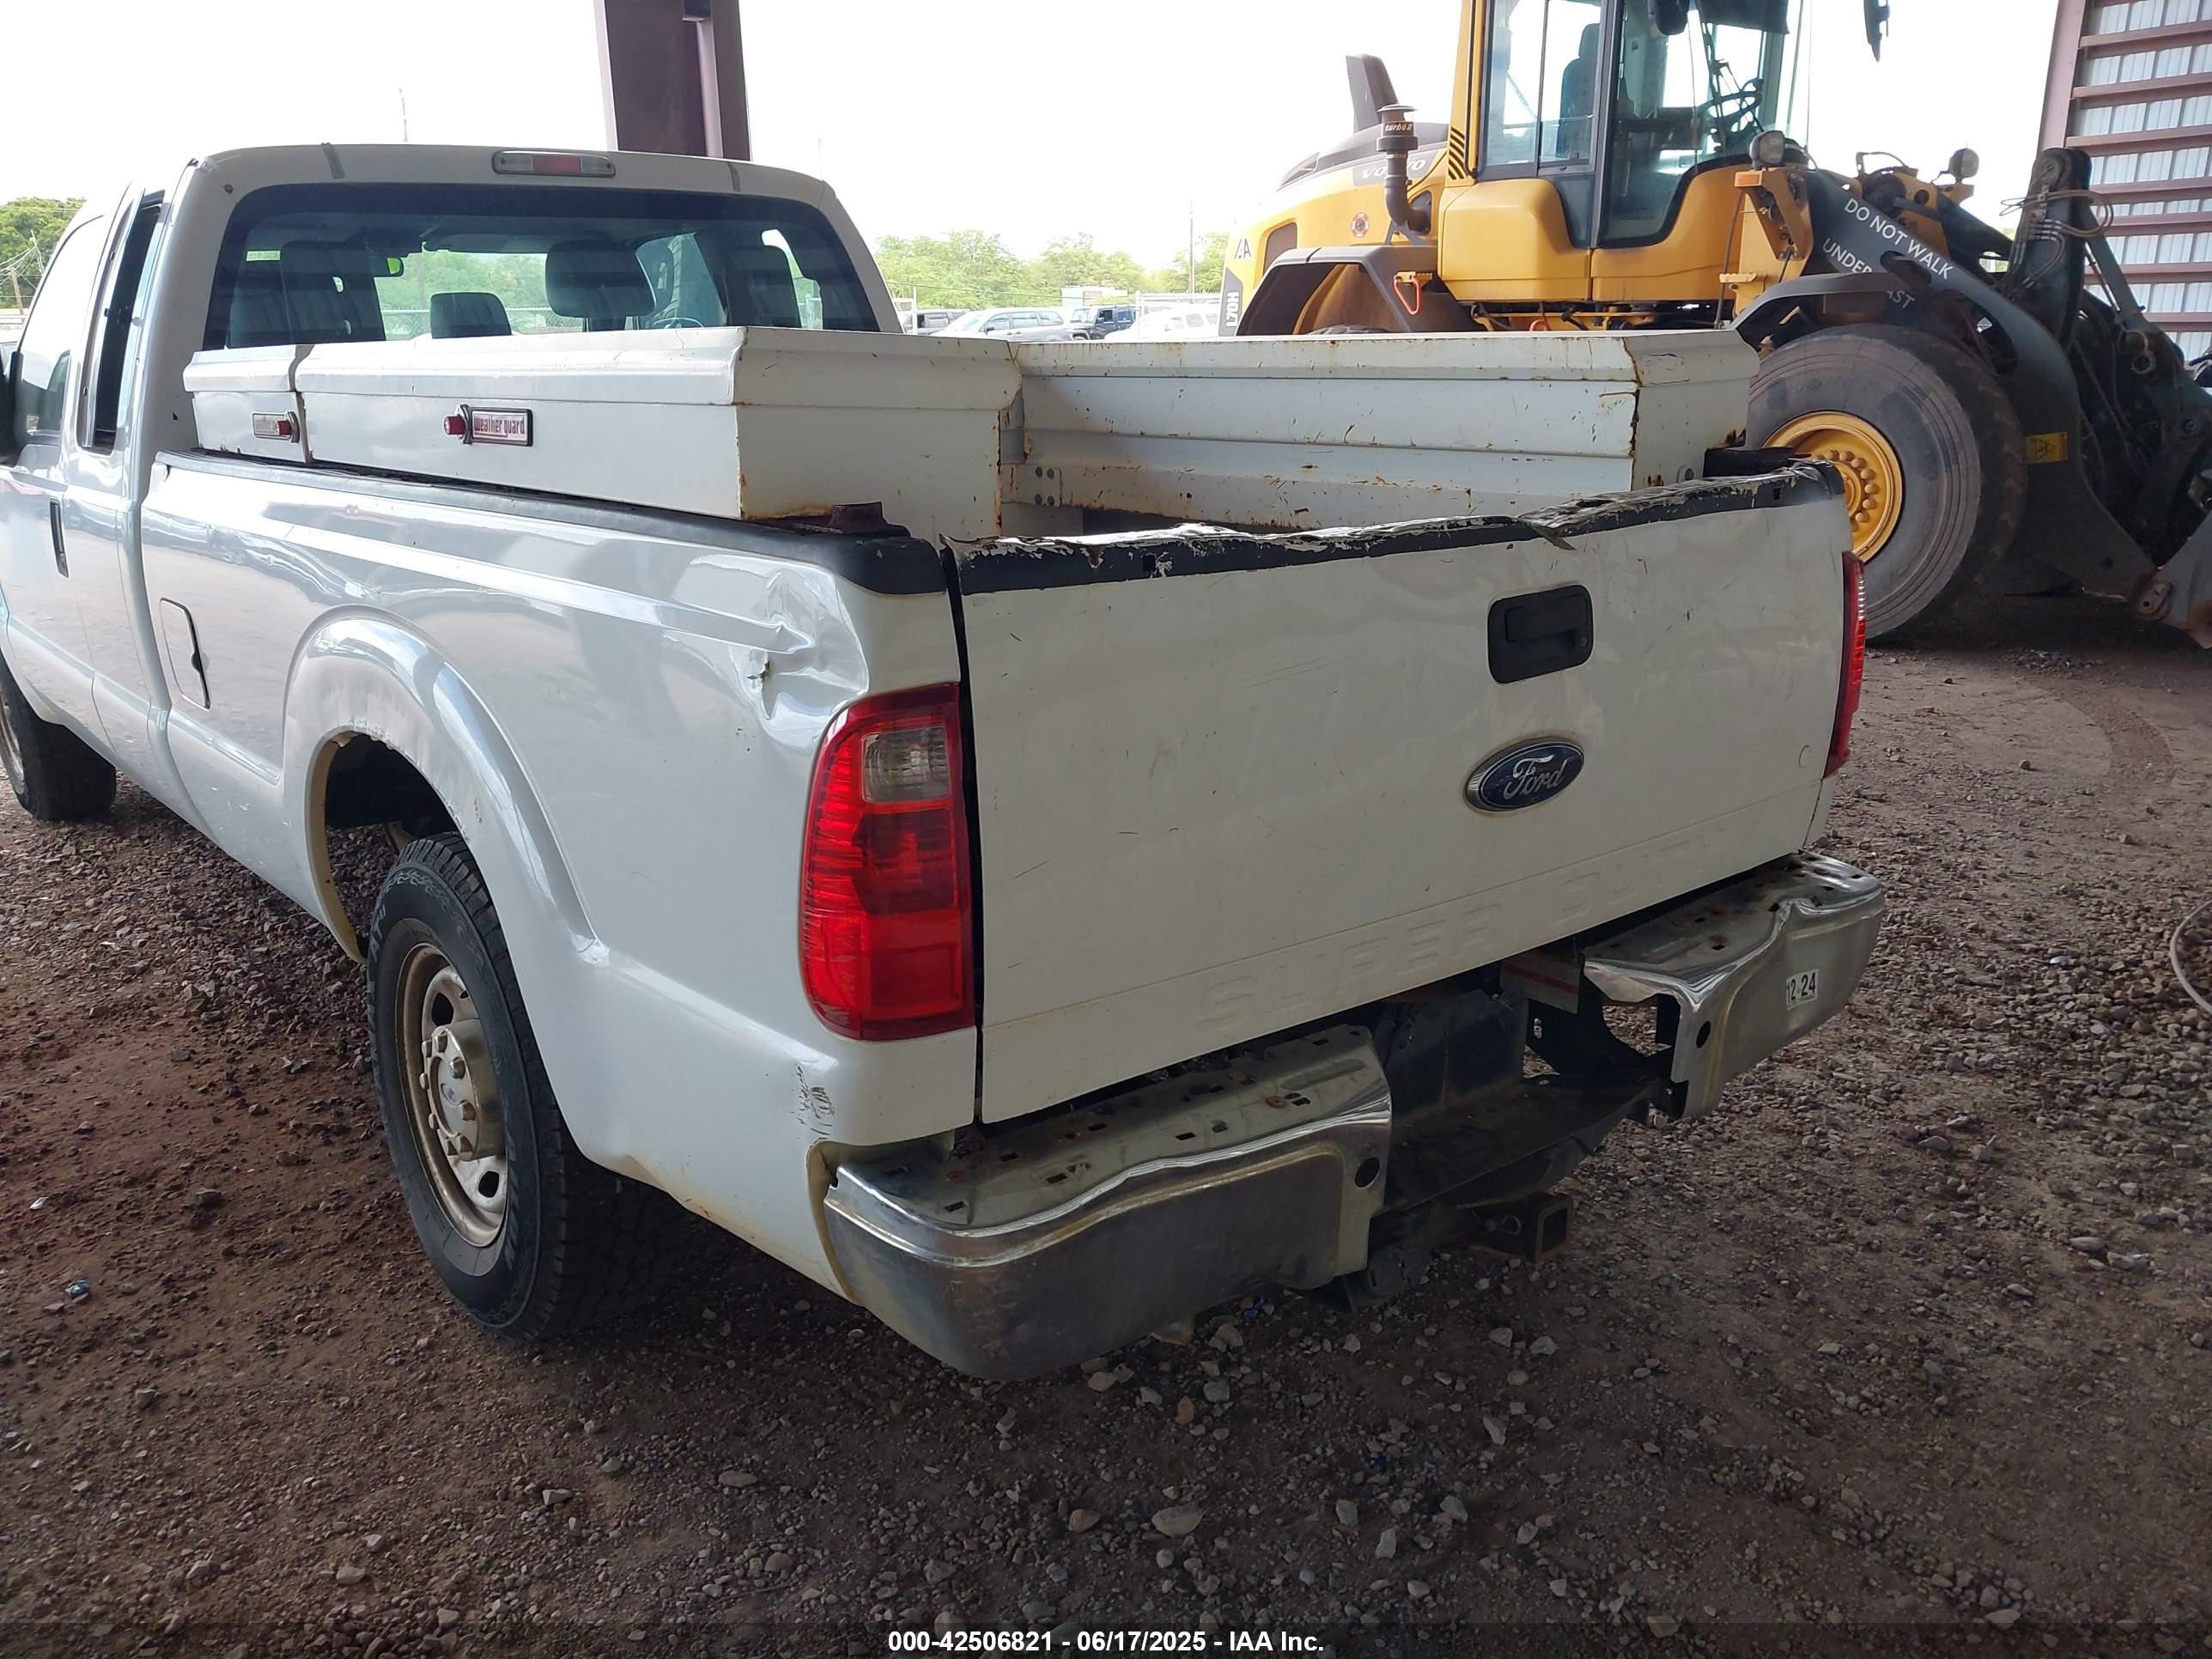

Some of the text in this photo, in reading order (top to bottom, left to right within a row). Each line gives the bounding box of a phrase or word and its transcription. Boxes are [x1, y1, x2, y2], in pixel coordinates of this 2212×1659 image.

[1362, 160, 1425, 179] VOO
[1844, 198, 1954, 280] DO NOT WALK
[1504, 754, 1568, 799] Ford
[1196, 902, 1503, 1032] SUPER
[1801, 972, 1816, 997] 24
